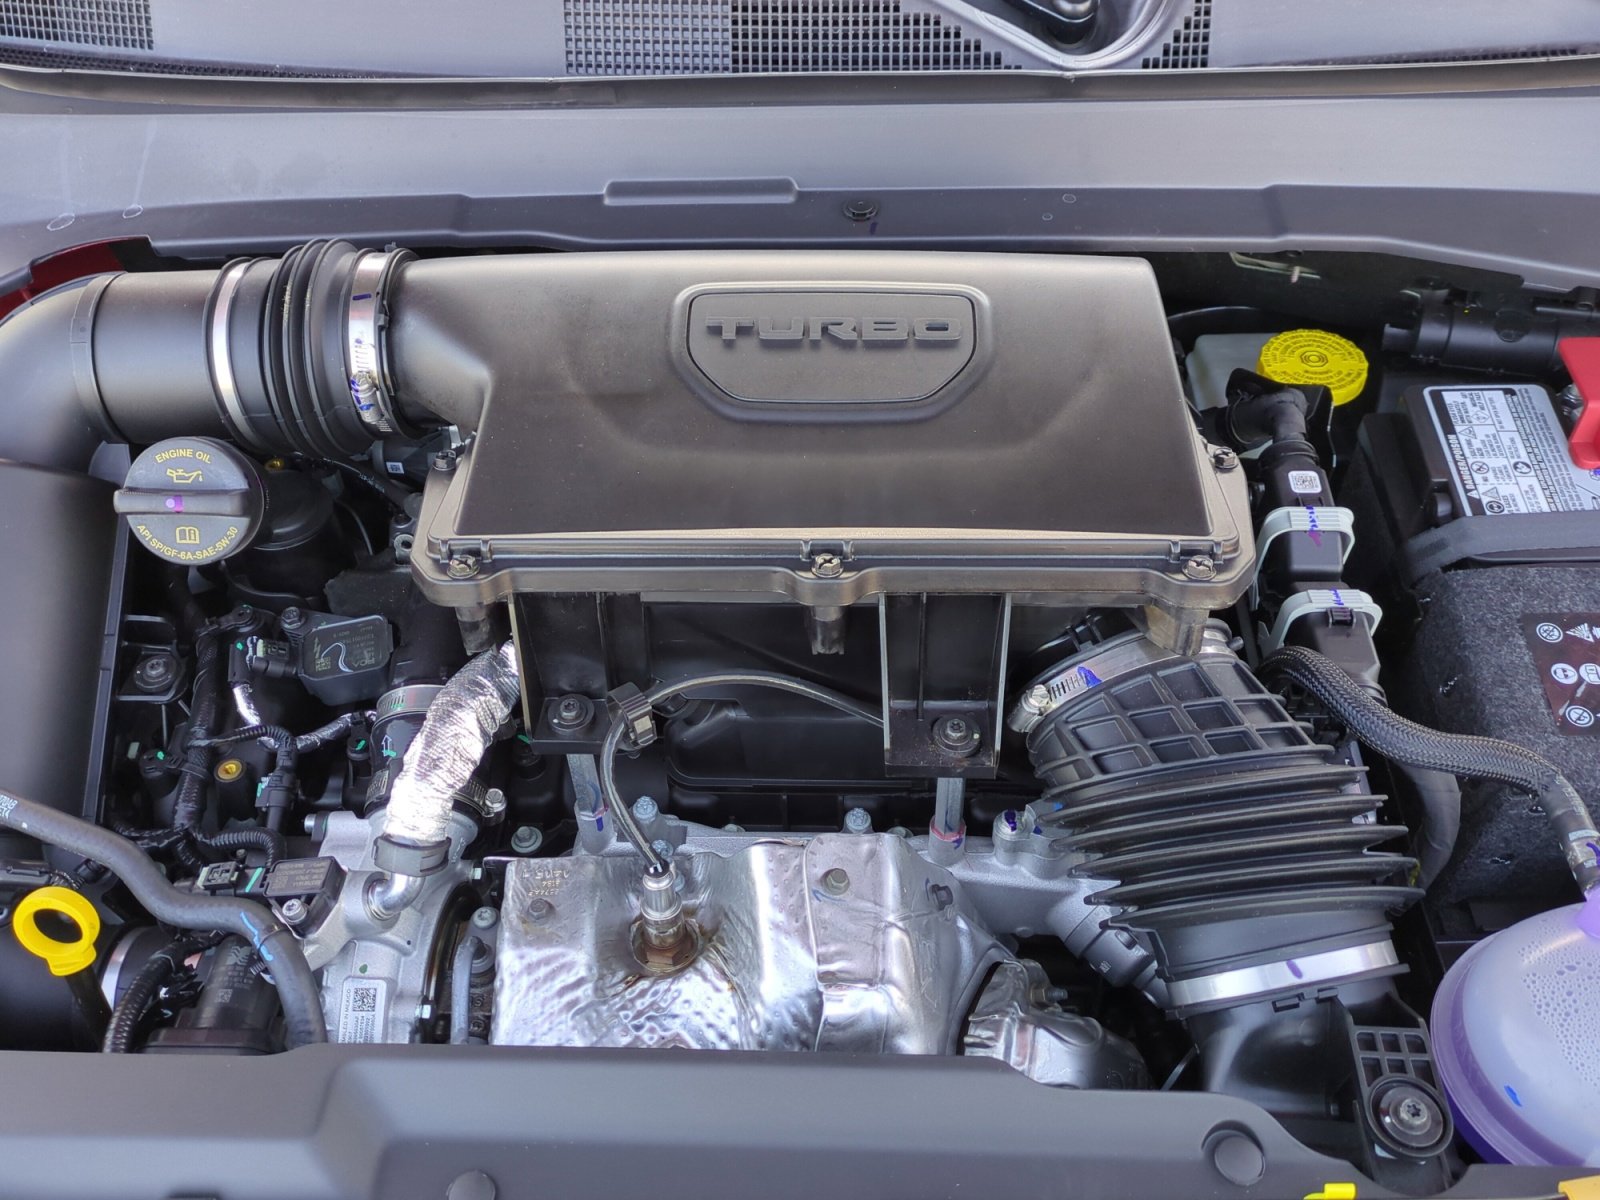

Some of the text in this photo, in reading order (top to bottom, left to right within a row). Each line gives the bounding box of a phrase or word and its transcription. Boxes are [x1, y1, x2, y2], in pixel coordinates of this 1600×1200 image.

[705, 316, 963, 342] TURBO
[155, 448, 212, 464] ENGINE OIL
[1447, 434, 1475, 488] DANGER/POISON
[136, 524, 152, 541] API
